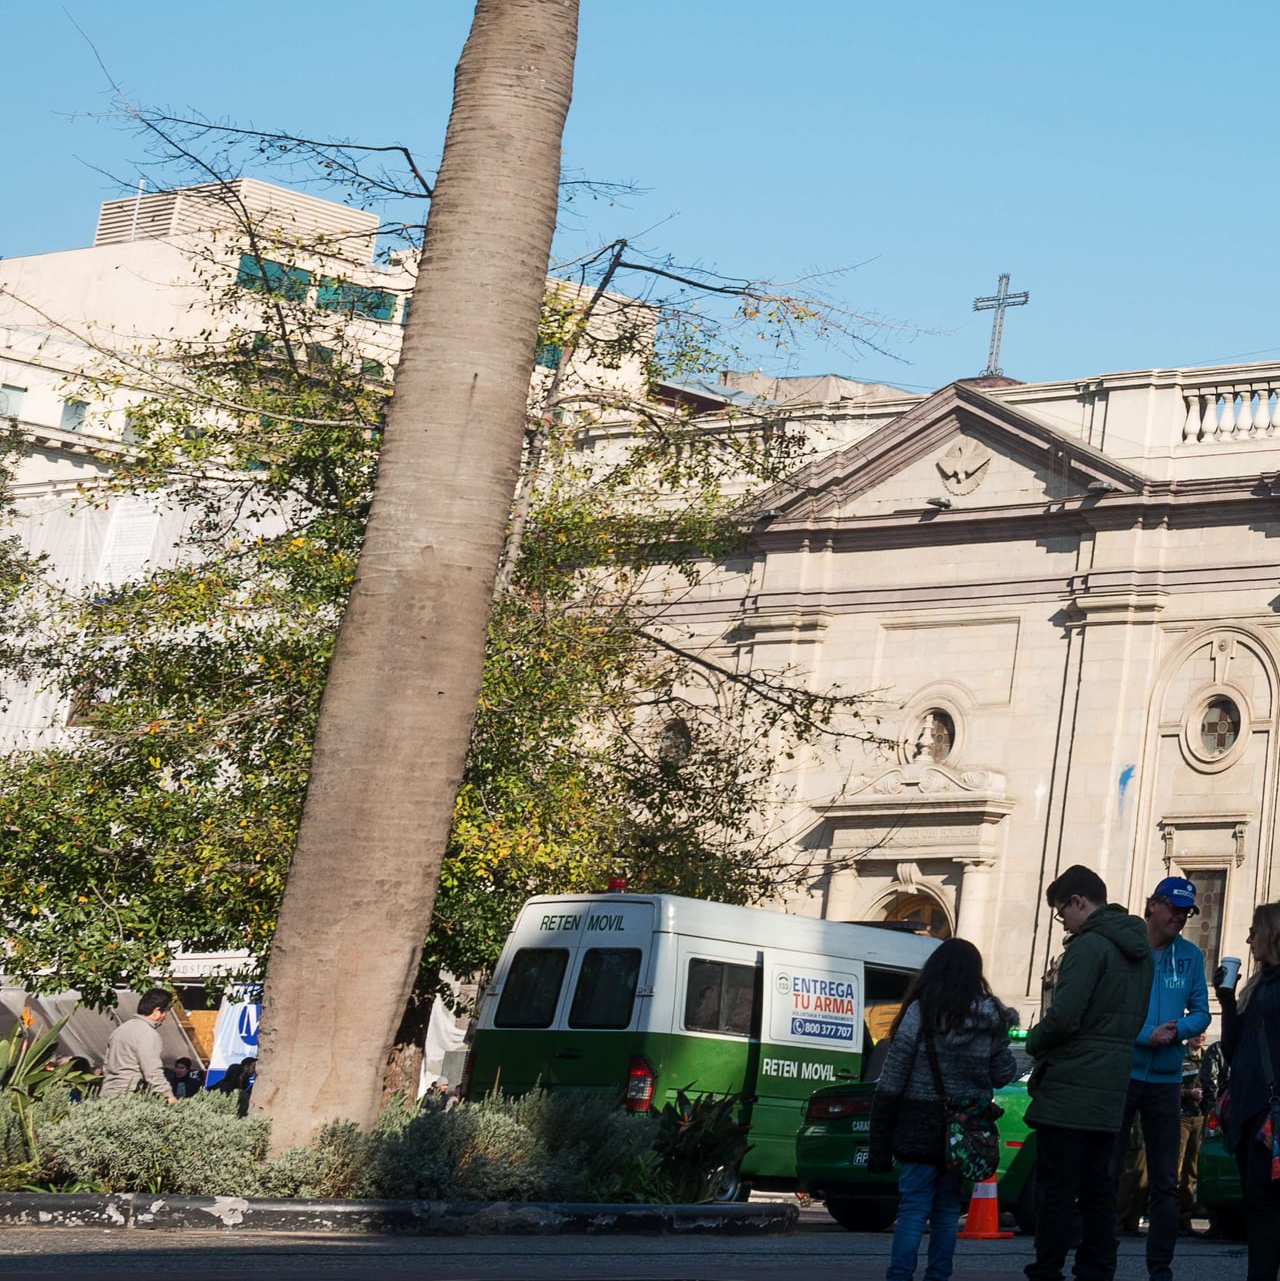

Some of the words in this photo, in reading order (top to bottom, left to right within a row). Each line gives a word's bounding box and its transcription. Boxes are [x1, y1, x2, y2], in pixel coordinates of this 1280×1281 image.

[540, 915, 582, 931] RETEN
[587, 915, 625, 931] MOVIL
[793, 977, 854, 999] ENTREGA
[793, 993, 810, 1010] TU
[814, 996, 854, 1016] ARMA
[805, 1022, 820, 1035] 800
[821, 1024, 836, 1036] 377
[837, 1026, 851, 1038] 707
[762, 1058, 798, 1078] RETEN
[801, 1062, 836, 1082] MOVIL
